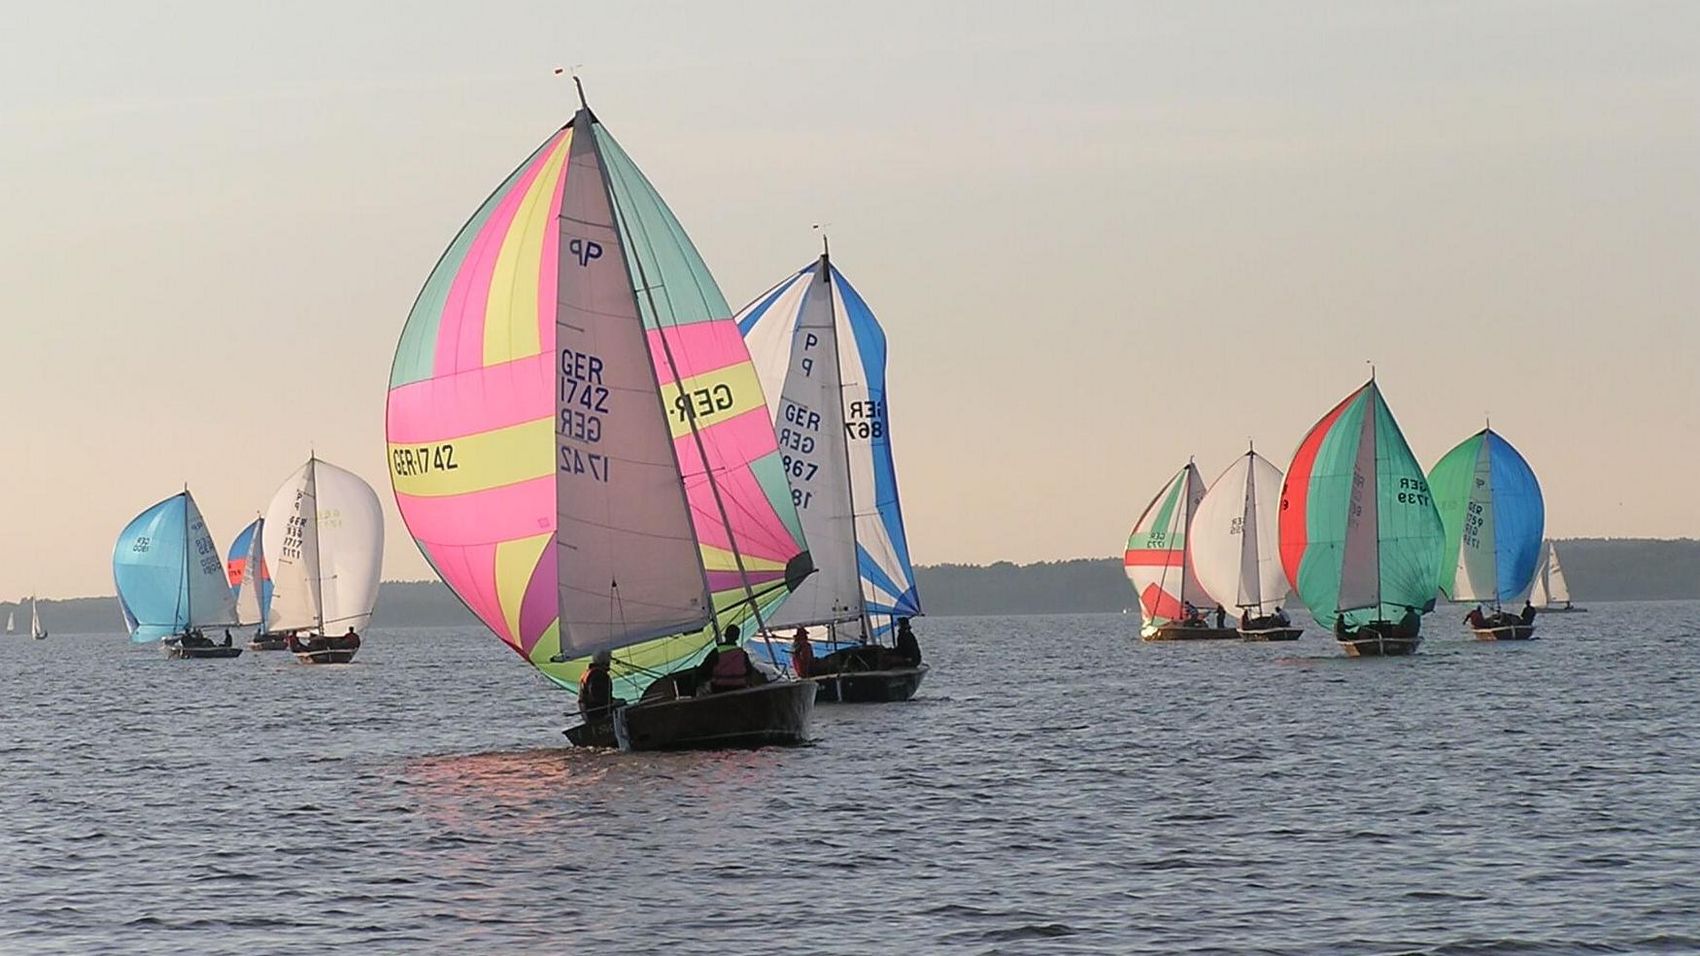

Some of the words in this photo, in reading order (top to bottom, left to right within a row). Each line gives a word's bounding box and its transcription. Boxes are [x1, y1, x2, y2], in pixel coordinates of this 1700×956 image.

[584, 241, 603, 267] P
[804, 333, 818, 351] P
[561, 348, 604, 385] GER
[560, 377, 609, 414] 1742
[785, 404, 821, 432] GER
[783, 455, 818, 481] 867
[283, 537, 303, 549] 1717
